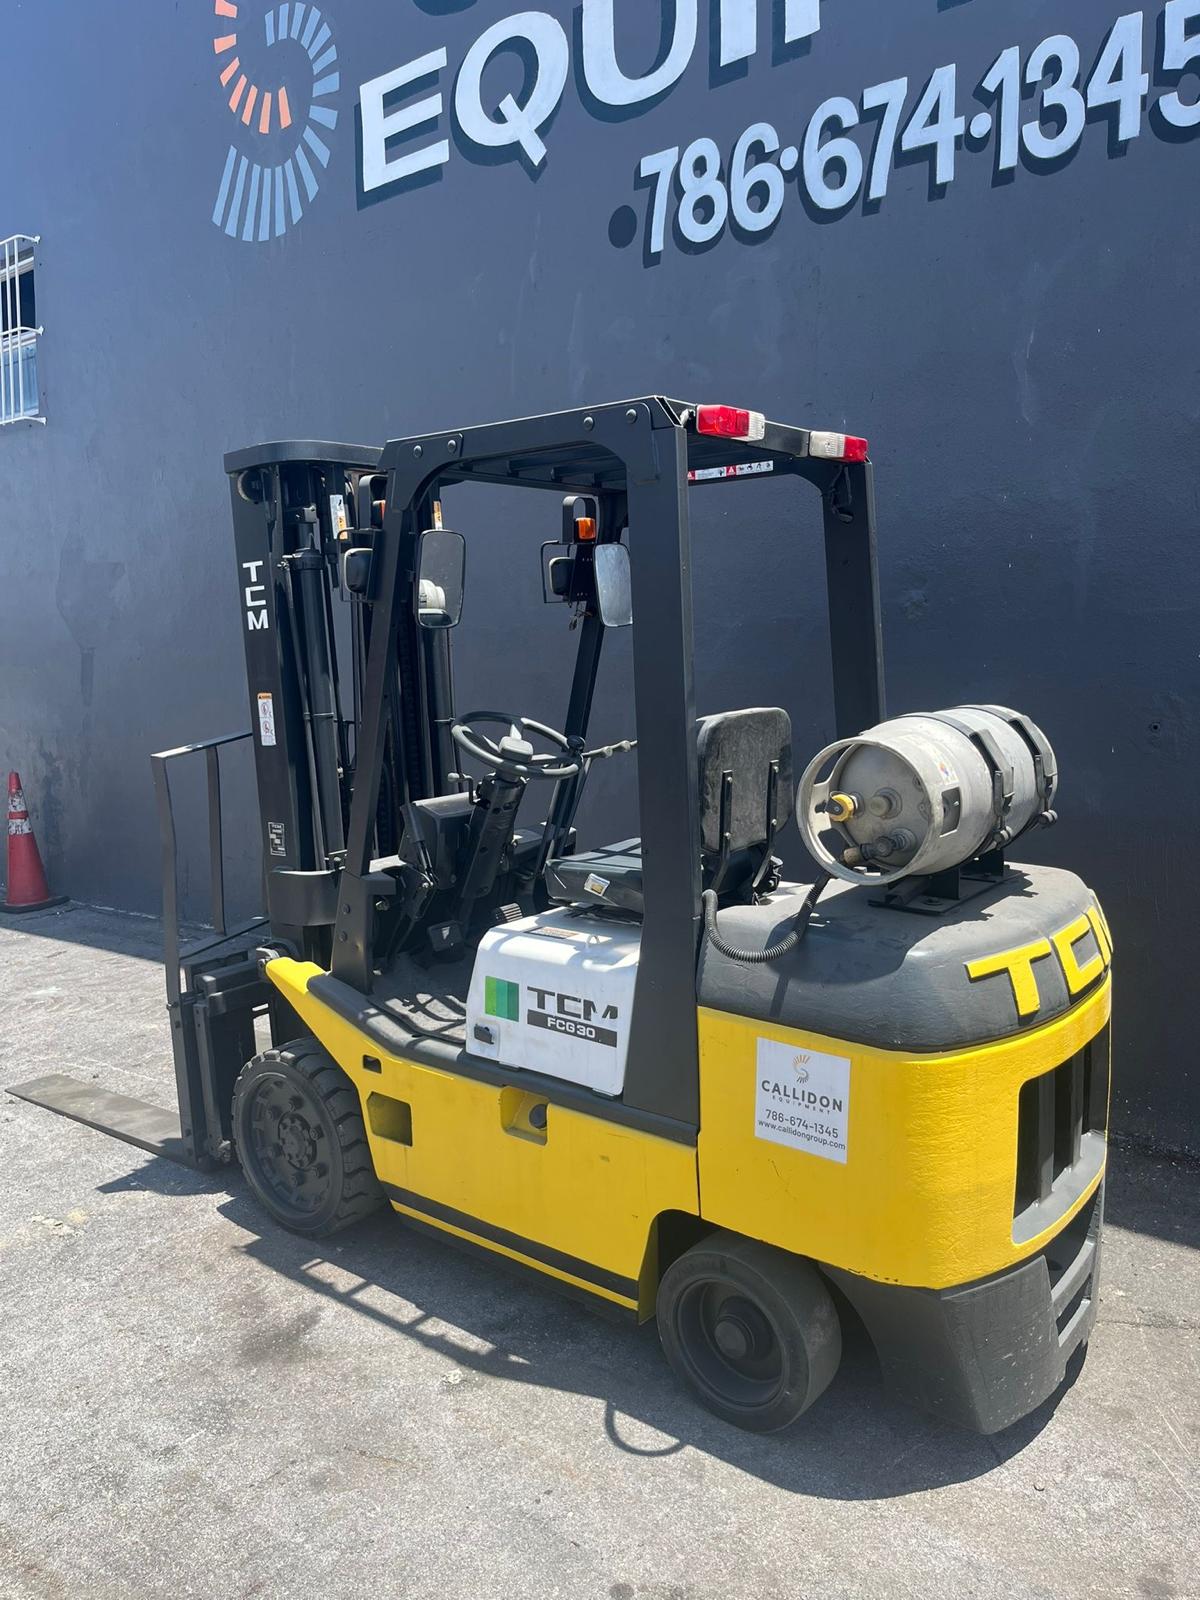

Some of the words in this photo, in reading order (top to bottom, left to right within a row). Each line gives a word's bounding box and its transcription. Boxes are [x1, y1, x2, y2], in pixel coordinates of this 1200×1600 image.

[359, 0, 821, 192] EQU
[242, 561, 269, 630] TCM
[527, 986, 618, 1021] TCM
[547, 1017, 596, 1038] FCG30
[761, 1080, 843, 1113] CALLIDON
[758, 1120, 846, 1150] www.callidongroup.com
[765, 1109, 839, 1139] 786-674-1345
